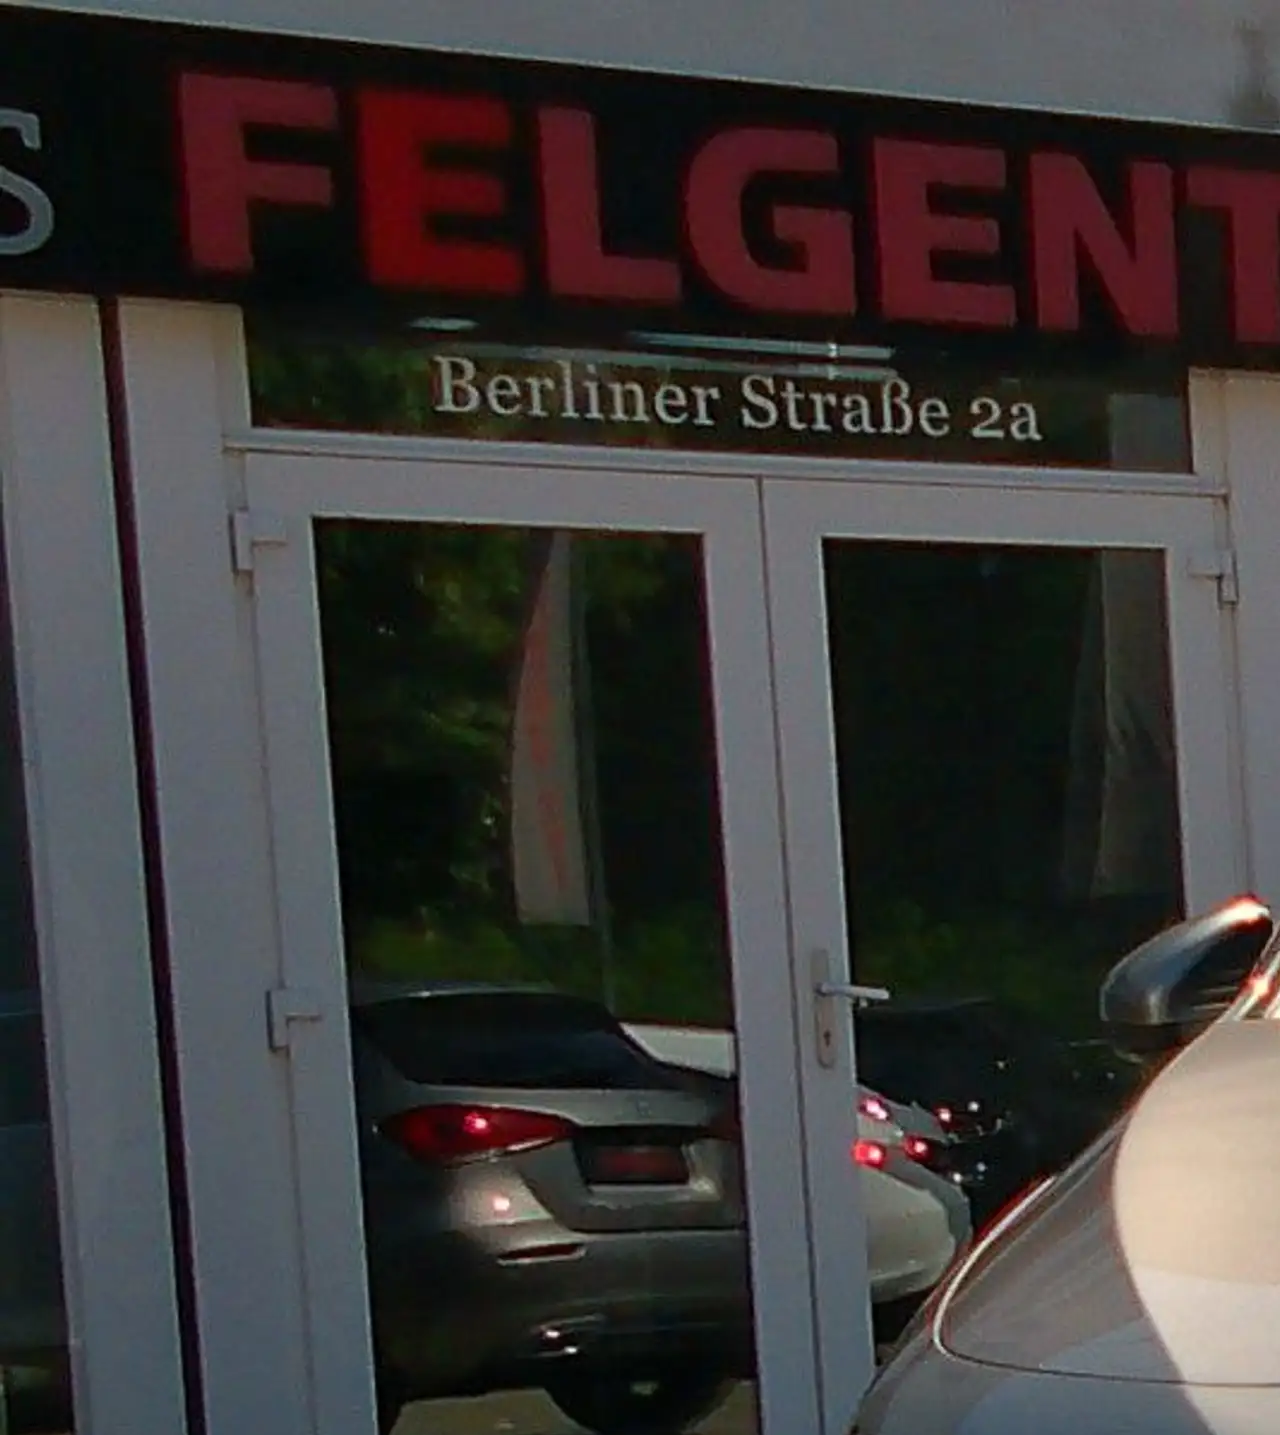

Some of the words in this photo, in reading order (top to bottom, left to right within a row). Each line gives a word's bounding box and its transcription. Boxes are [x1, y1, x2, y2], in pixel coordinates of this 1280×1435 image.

[432, 354, 722, 428] Berliner
[740, 372, 951, 437] Straße
[970, 397, 1043, 442] 2a
